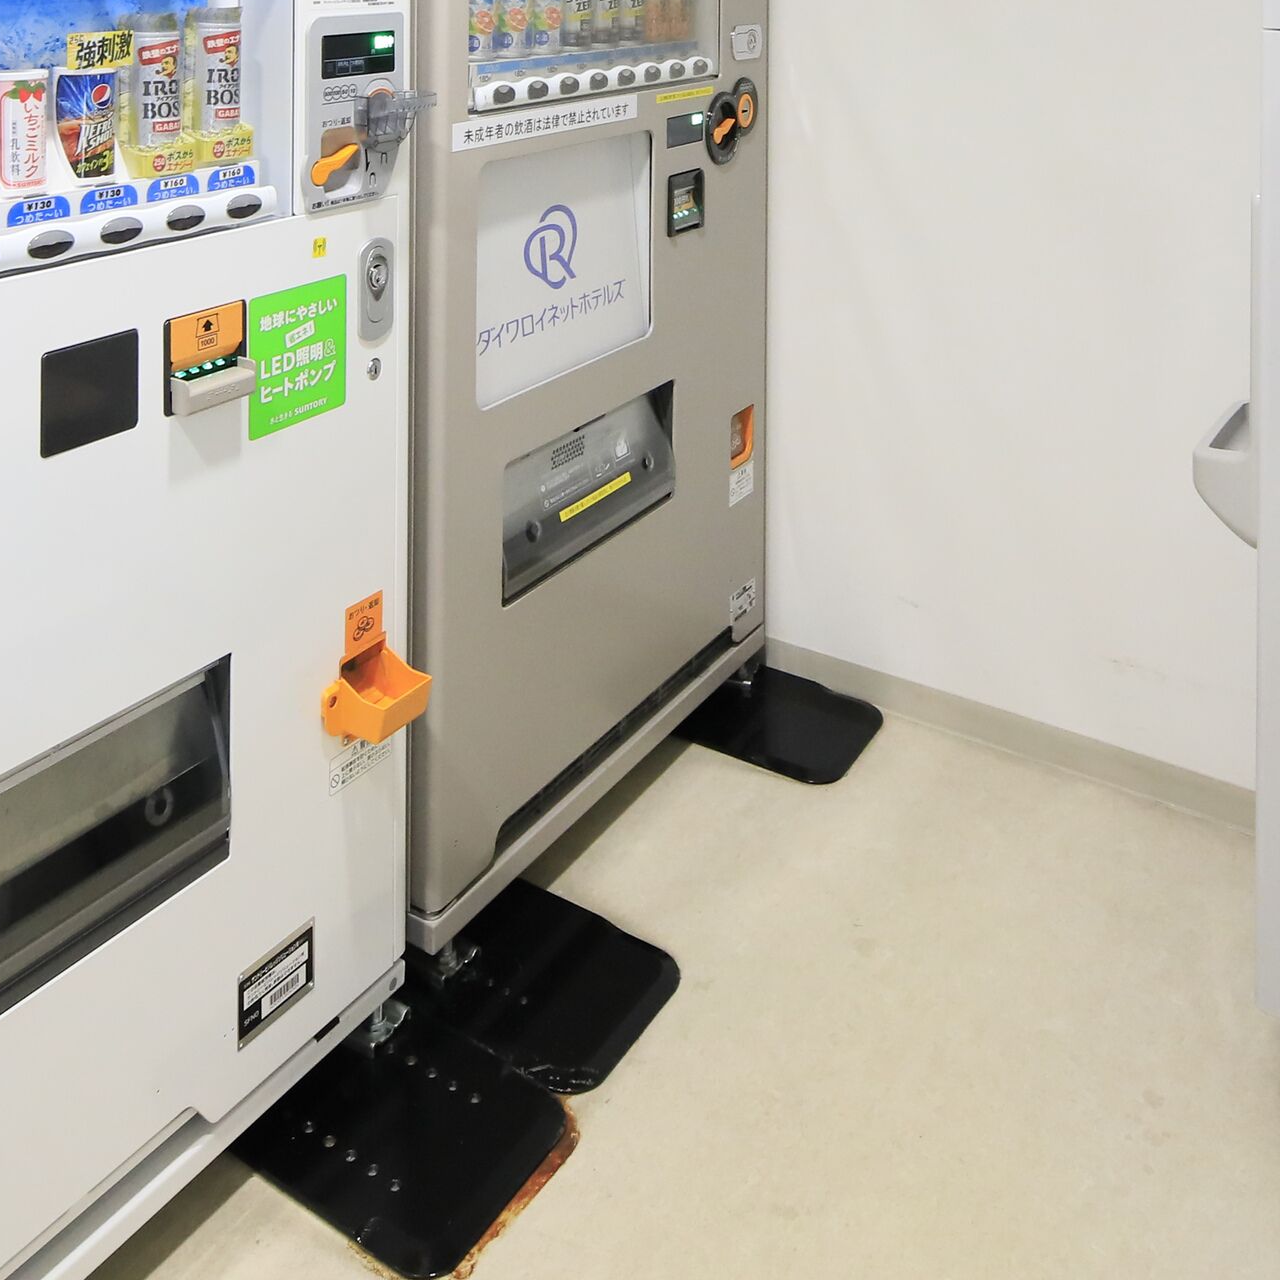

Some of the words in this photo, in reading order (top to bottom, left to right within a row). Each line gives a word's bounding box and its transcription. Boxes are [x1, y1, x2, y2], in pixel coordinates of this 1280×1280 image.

[75, 30, 134, 70] 強刺激
[463, 102, 630, 145] 未成年者の飲酒は法律で禁止されています
[23, 102, 40, 179] いちごミルク
[162, 178, 185, 188] ¥160
[221, 168, 242, 178] ¥160
[25, 199, 54, 213] ¥130
[96, 188, 123, 200] ¥130
[259, 298, 338, 332] 地球にやさしい
[477, 278, 626, 356] ダイワロイネットホテルズ
[200, 337, 215, 347] 1000
[260, 359, 337, 404] ヒートポンプ
[294, 397, 328, 417] SUNTORY
